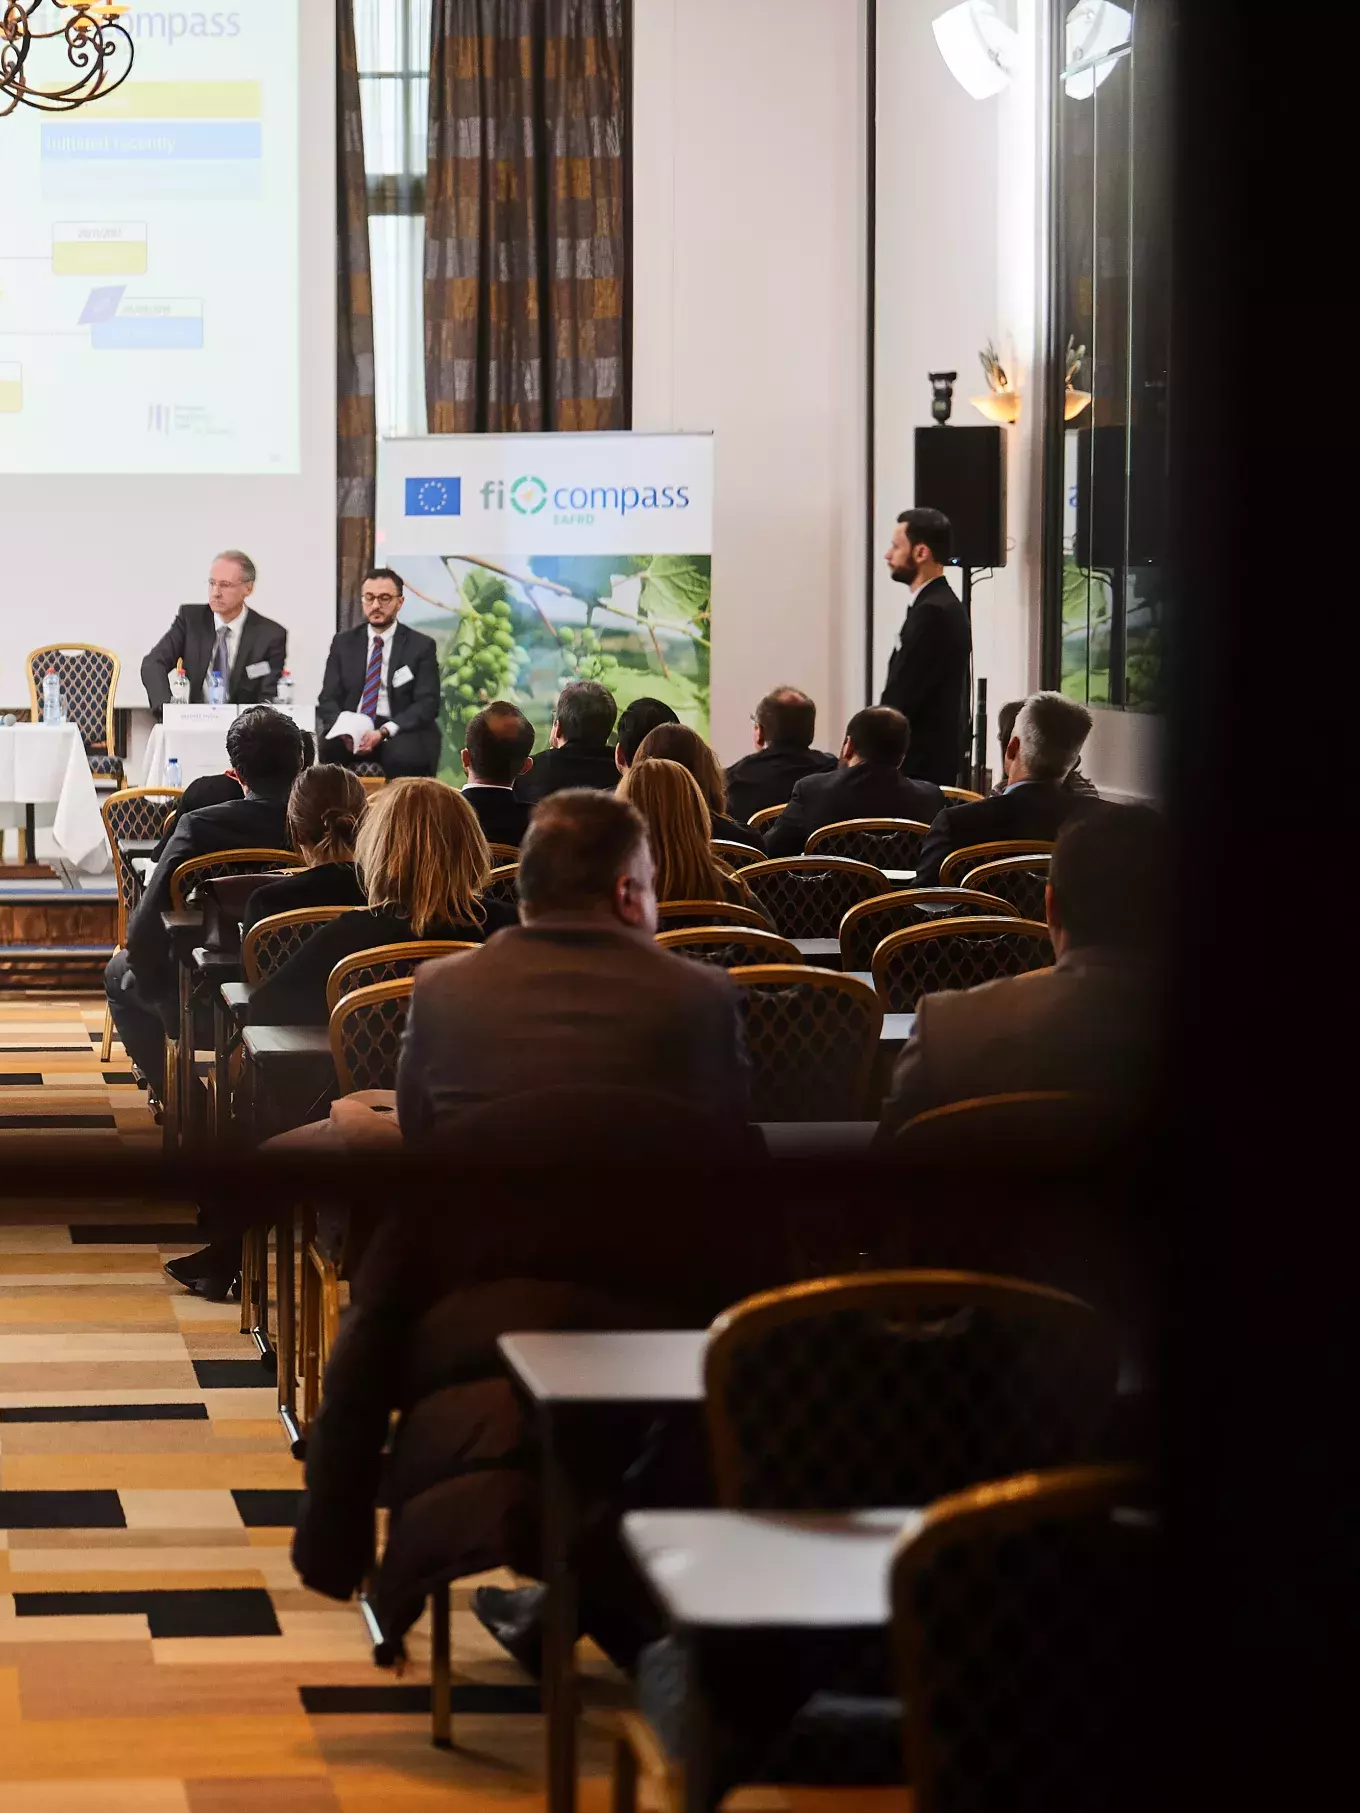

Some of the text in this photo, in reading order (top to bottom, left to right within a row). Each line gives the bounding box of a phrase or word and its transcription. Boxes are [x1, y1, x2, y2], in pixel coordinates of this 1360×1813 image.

[104, 11, 241, 45] ompass
[479, 480, 690, 516] fi compass
